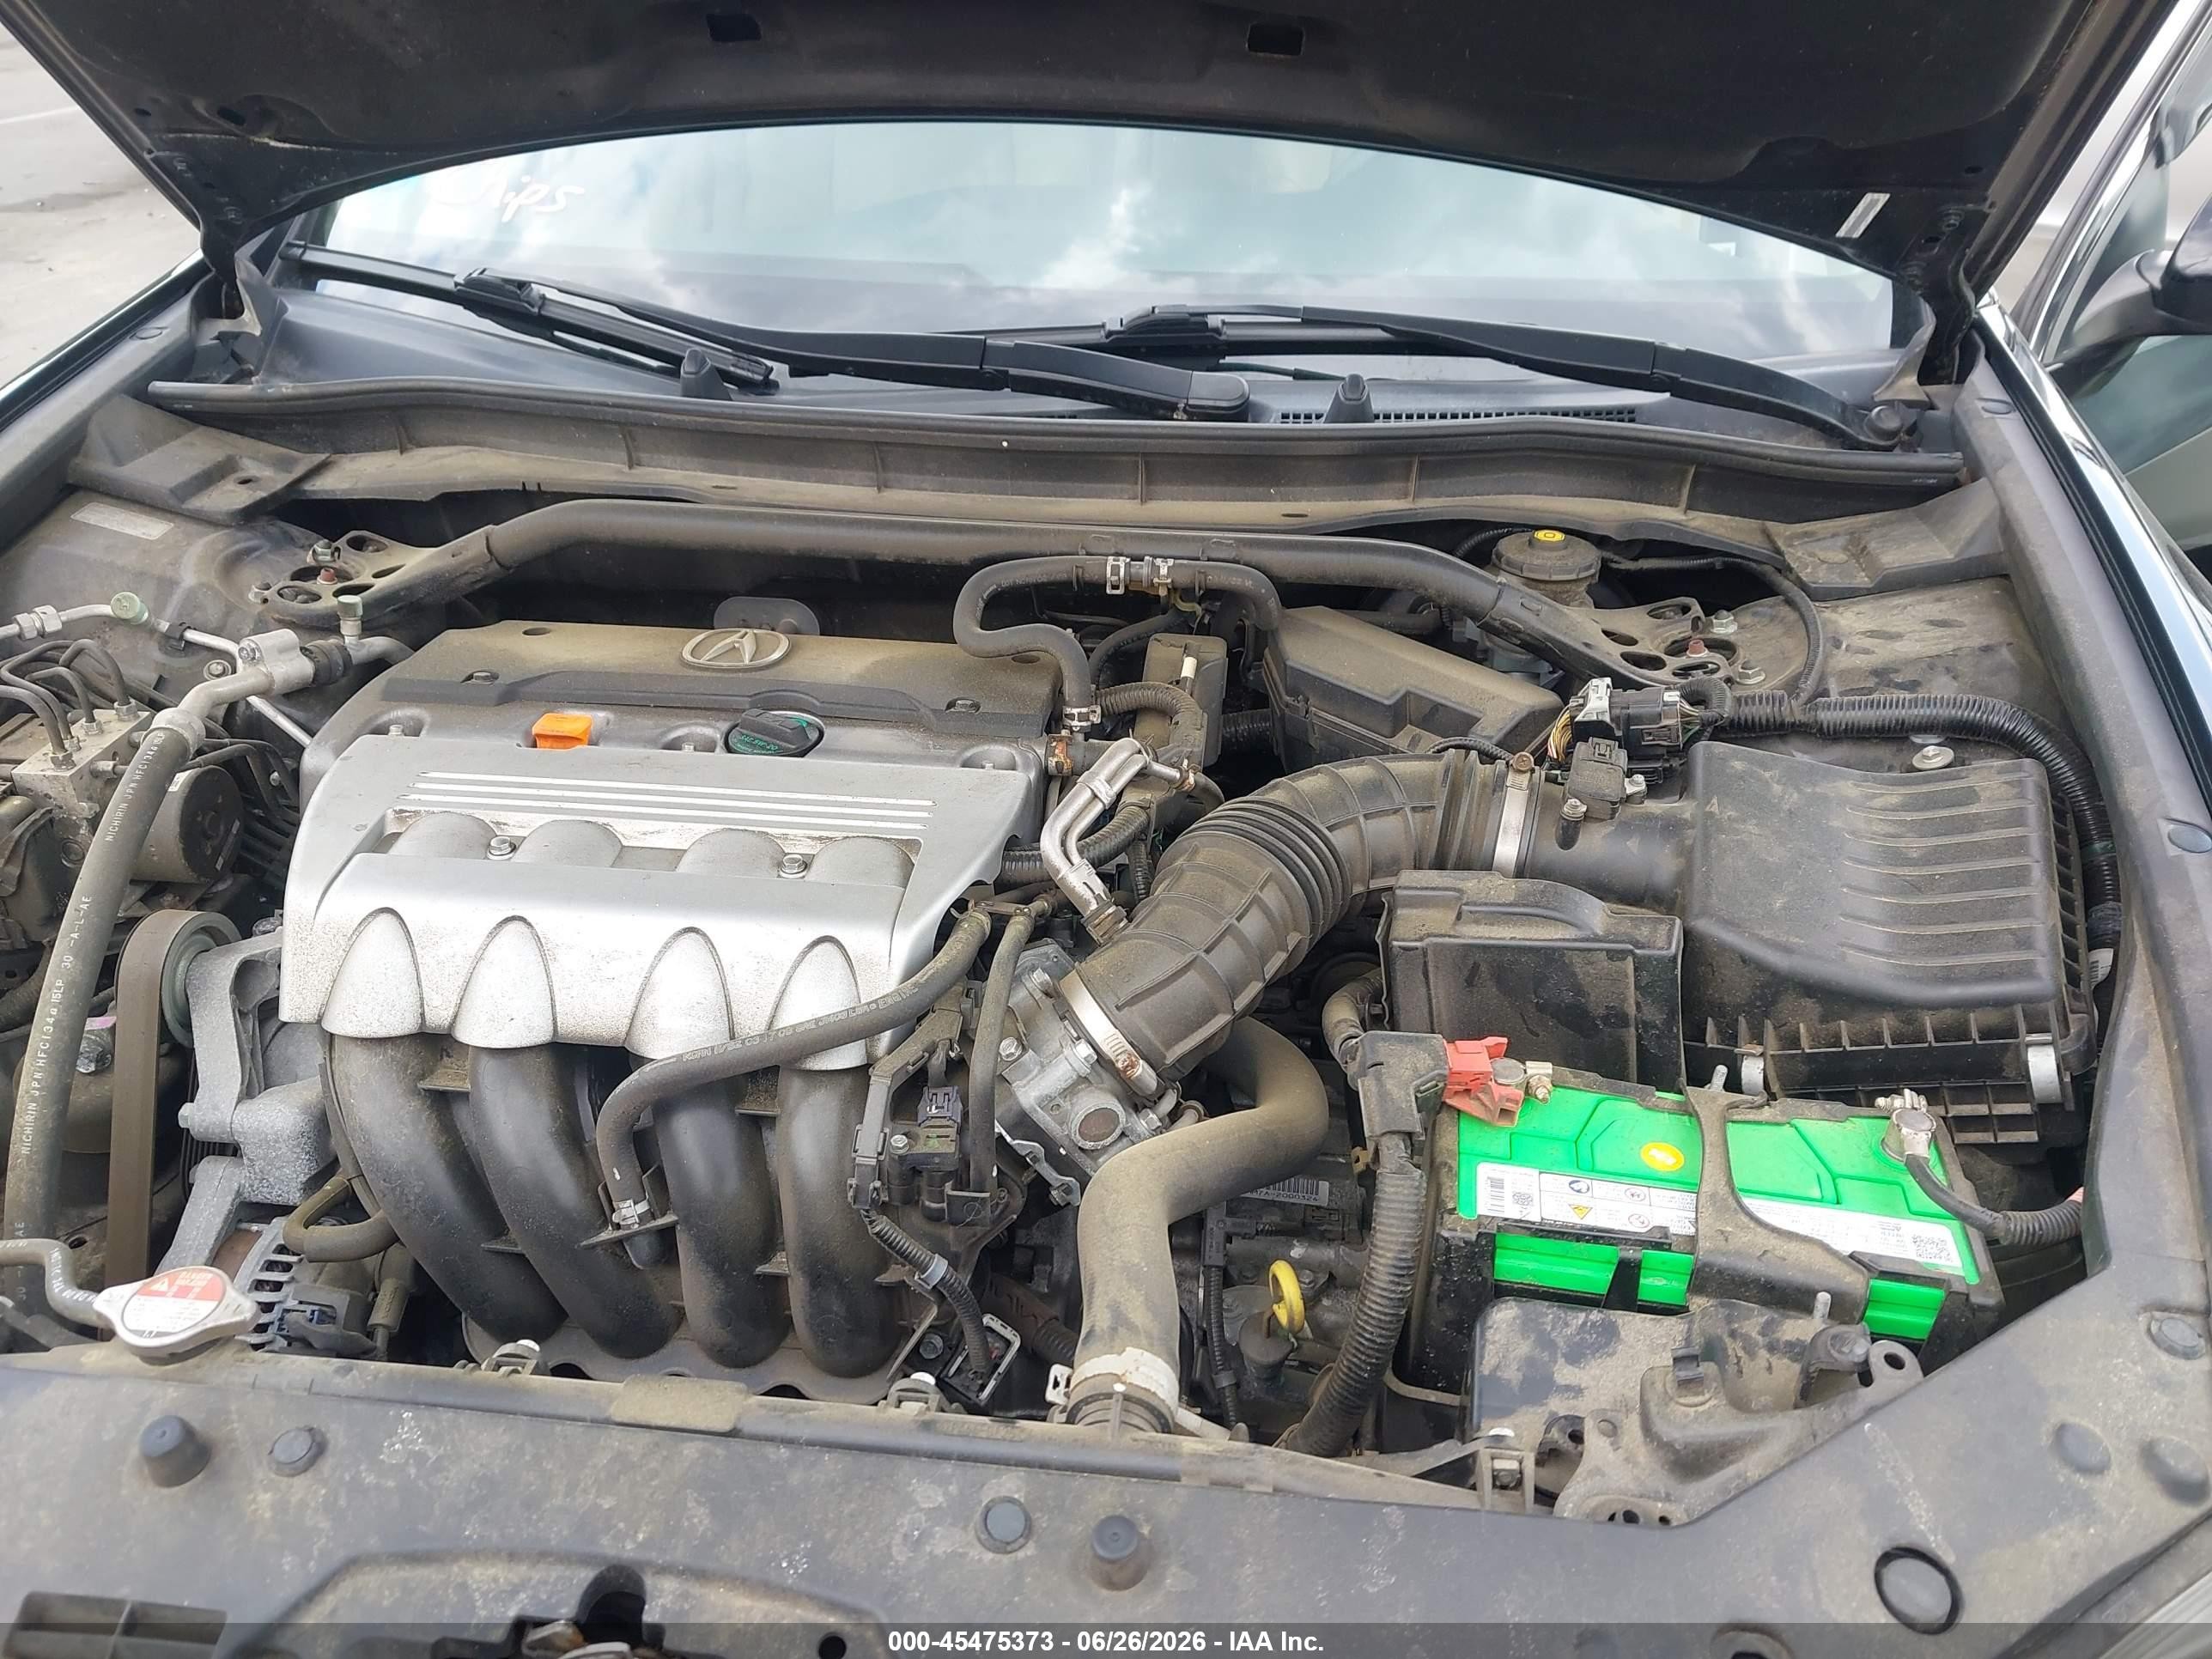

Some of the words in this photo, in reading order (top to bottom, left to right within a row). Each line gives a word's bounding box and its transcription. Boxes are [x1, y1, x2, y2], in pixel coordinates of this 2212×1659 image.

[105, 801, 129, 842] NICHIRIN
[126, 778, 138, 800] JPN
[21, 1102, 37, 1155] NICHIRIN
[30, 1072, 43, 1097] JPN
[51, 979, 65, 1003] 15LP
[61, 954, 74, 969] 30
